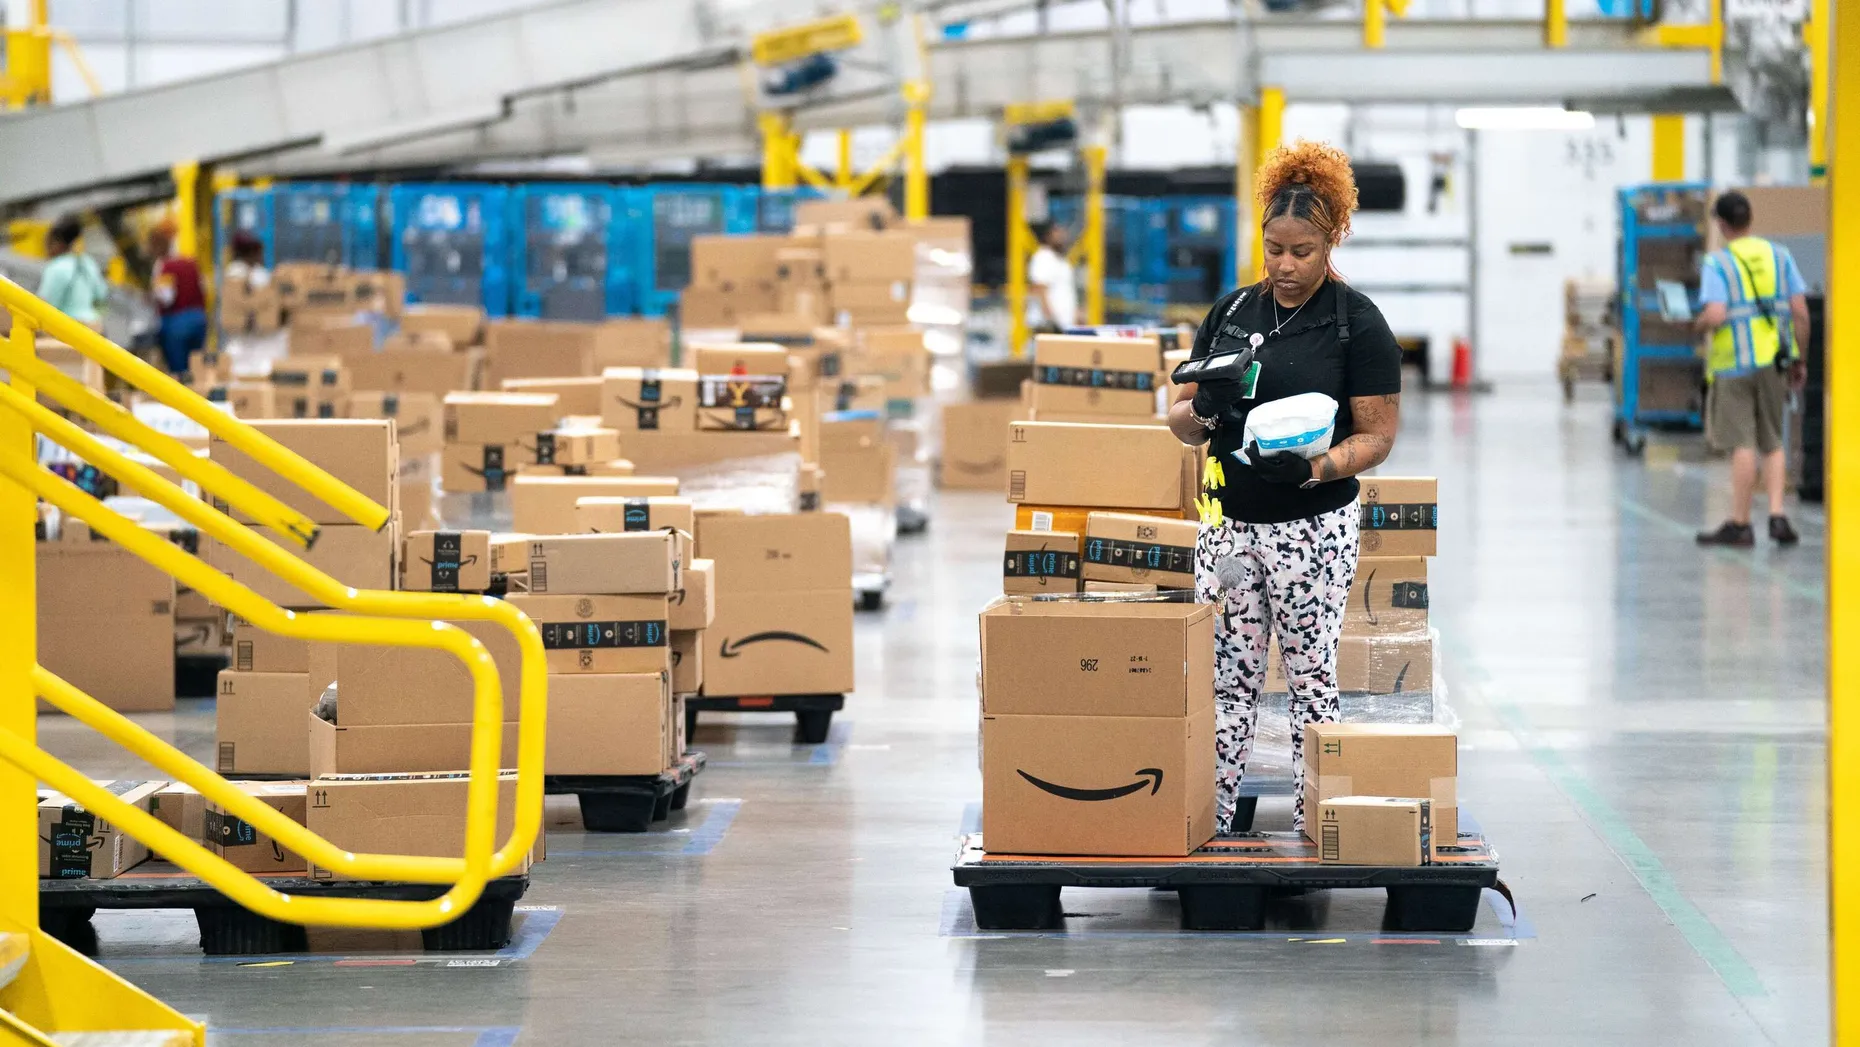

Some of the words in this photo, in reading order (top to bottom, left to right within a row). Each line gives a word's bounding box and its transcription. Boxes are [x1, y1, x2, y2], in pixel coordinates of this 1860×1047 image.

[1372, 506, 1380, 527] prime
[1095, 540, 1103, 560] prime
[1153, 546, 1161, 568] prime
[437, 561, 459, 569] prime
[1028, 553, 1036, 574] prime
[1048, 553, 1056, 574] prime
[587, 624, 596, 645] prime
[645, 622, 653, 644] prime
[1080, 658, 1099, 671] 296
[56, 839, 81, 848] prime
[61, 867, 87, 876] prime
